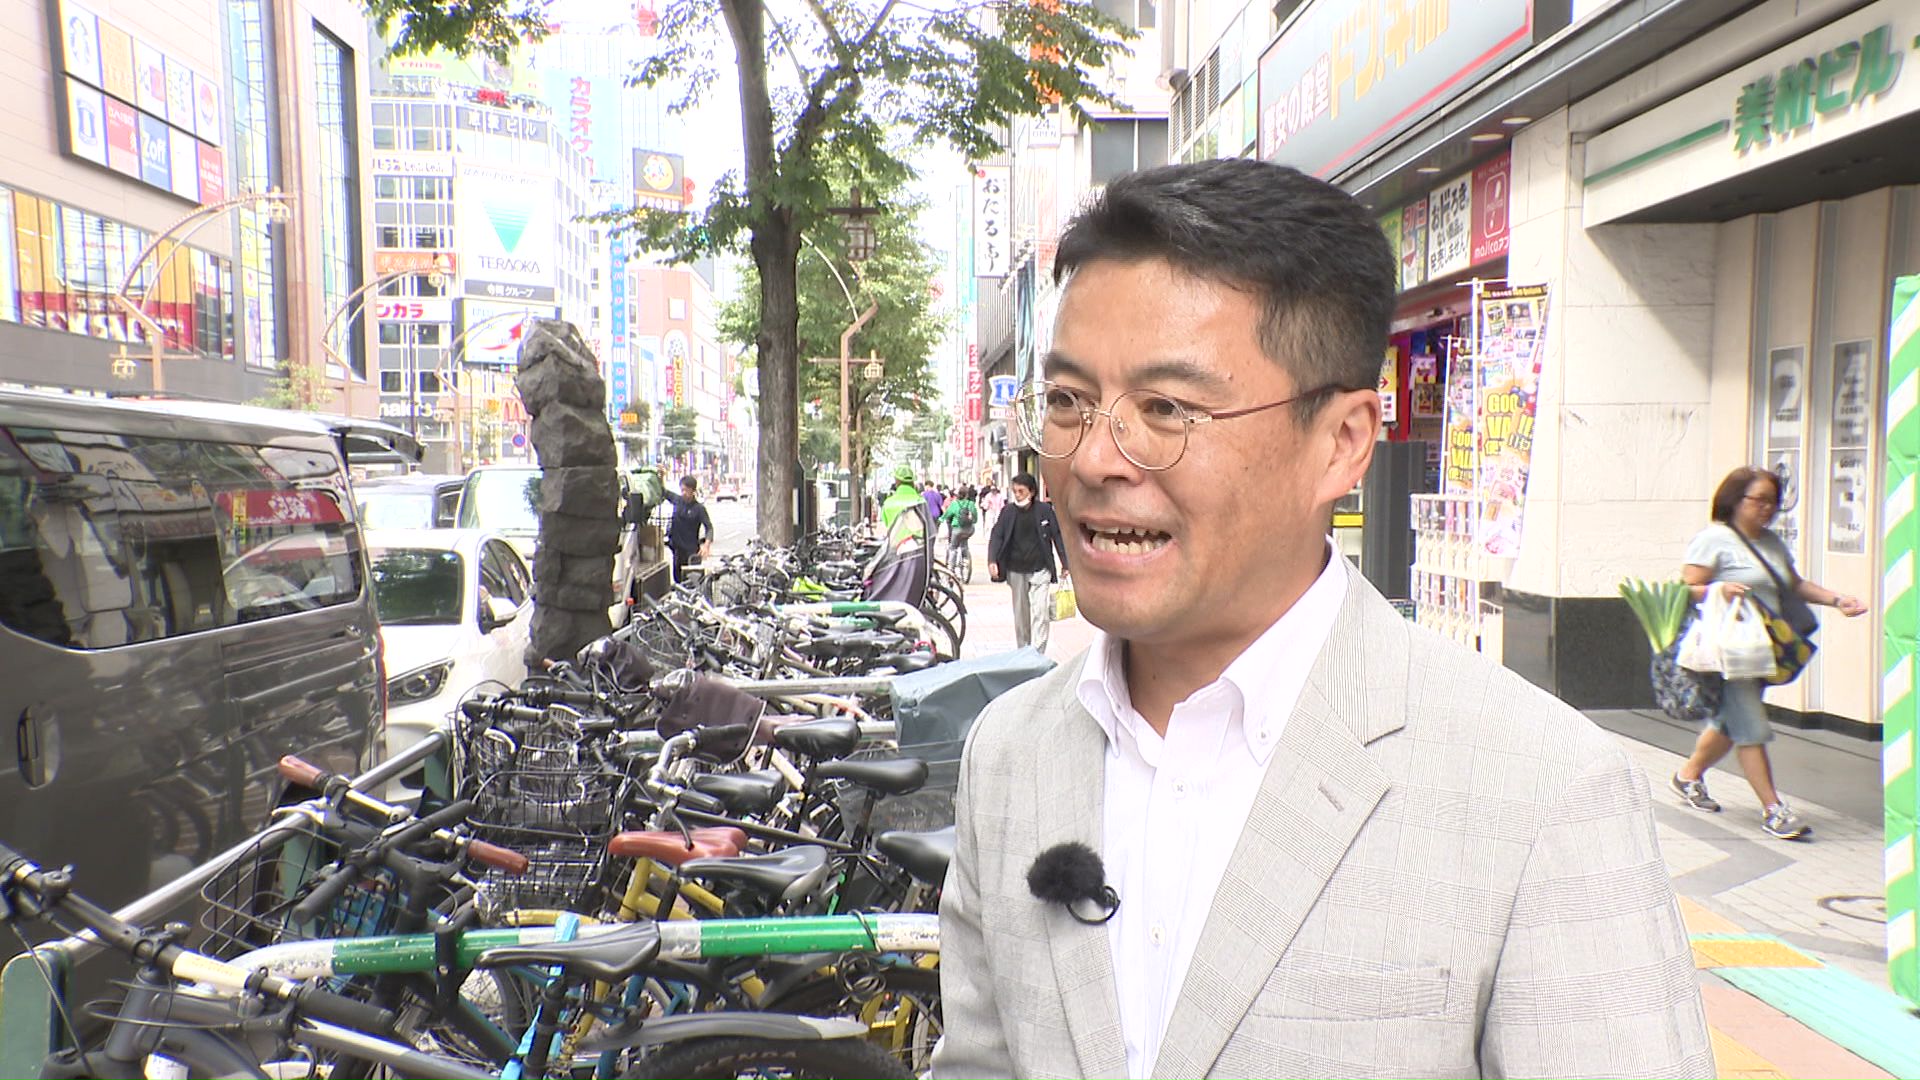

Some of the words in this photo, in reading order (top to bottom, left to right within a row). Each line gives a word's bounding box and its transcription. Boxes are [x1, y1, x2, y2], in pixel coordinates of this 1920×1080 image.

[143, 131, 167, 165] Zoff
[478, 256, 541, 274] TERAOKA
[1772, 358, 1803, 438] 2
[1831, 460, 1866, 541] 3
